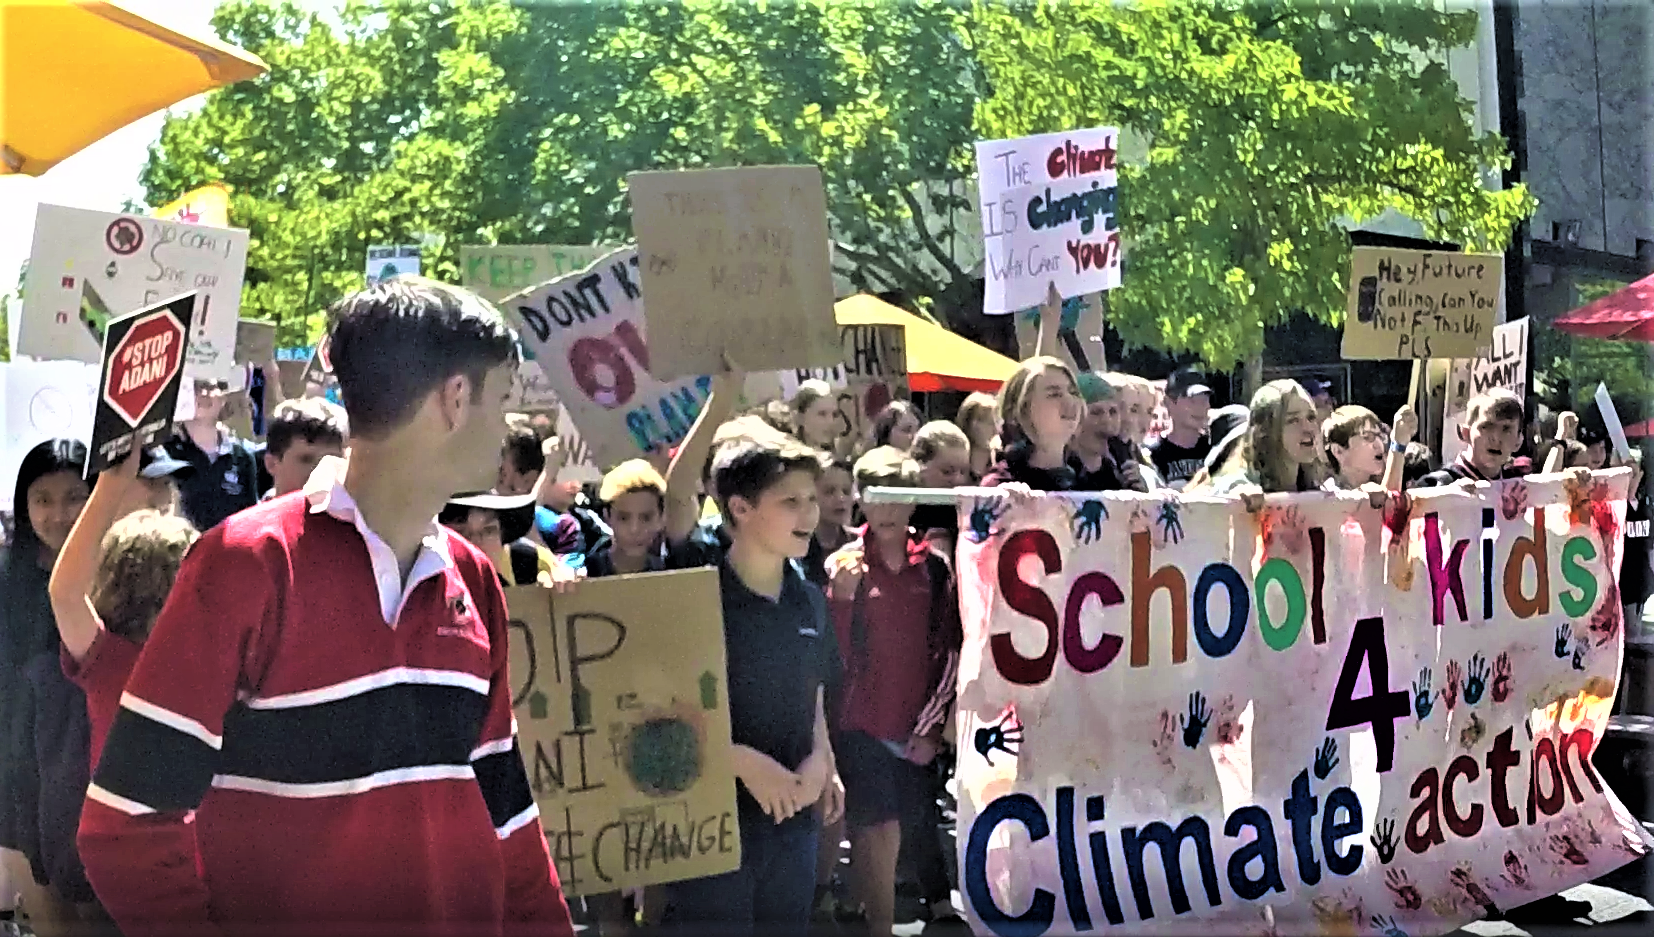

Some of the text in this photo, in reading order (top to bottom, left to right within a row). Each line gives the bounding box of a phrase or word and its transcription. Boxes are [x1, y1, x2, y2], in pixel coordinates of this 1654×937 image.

[984, 199, 1018, 238] IS
[467, 254, 537, 288] KEEP
[1066, 232, 1120, 275] YOU?
[1421, 253, 1485, 280] Future
[518, 272, 610, 343] DONT
[1469, 289, 1495, 310] You
[1373, 308, 1407, 331] Not
[1463, 314, 1483, 340] Up
[118, 353, 168, 395] ADANI
[1473, 360, 1522, 393] WANT
[990, 507, 1598, 687] School kids
[1325, 616, 1412, 774] 4
[592, 812, 733, 882] CHANGE
[965, 725, 1604, 937] Climate action
